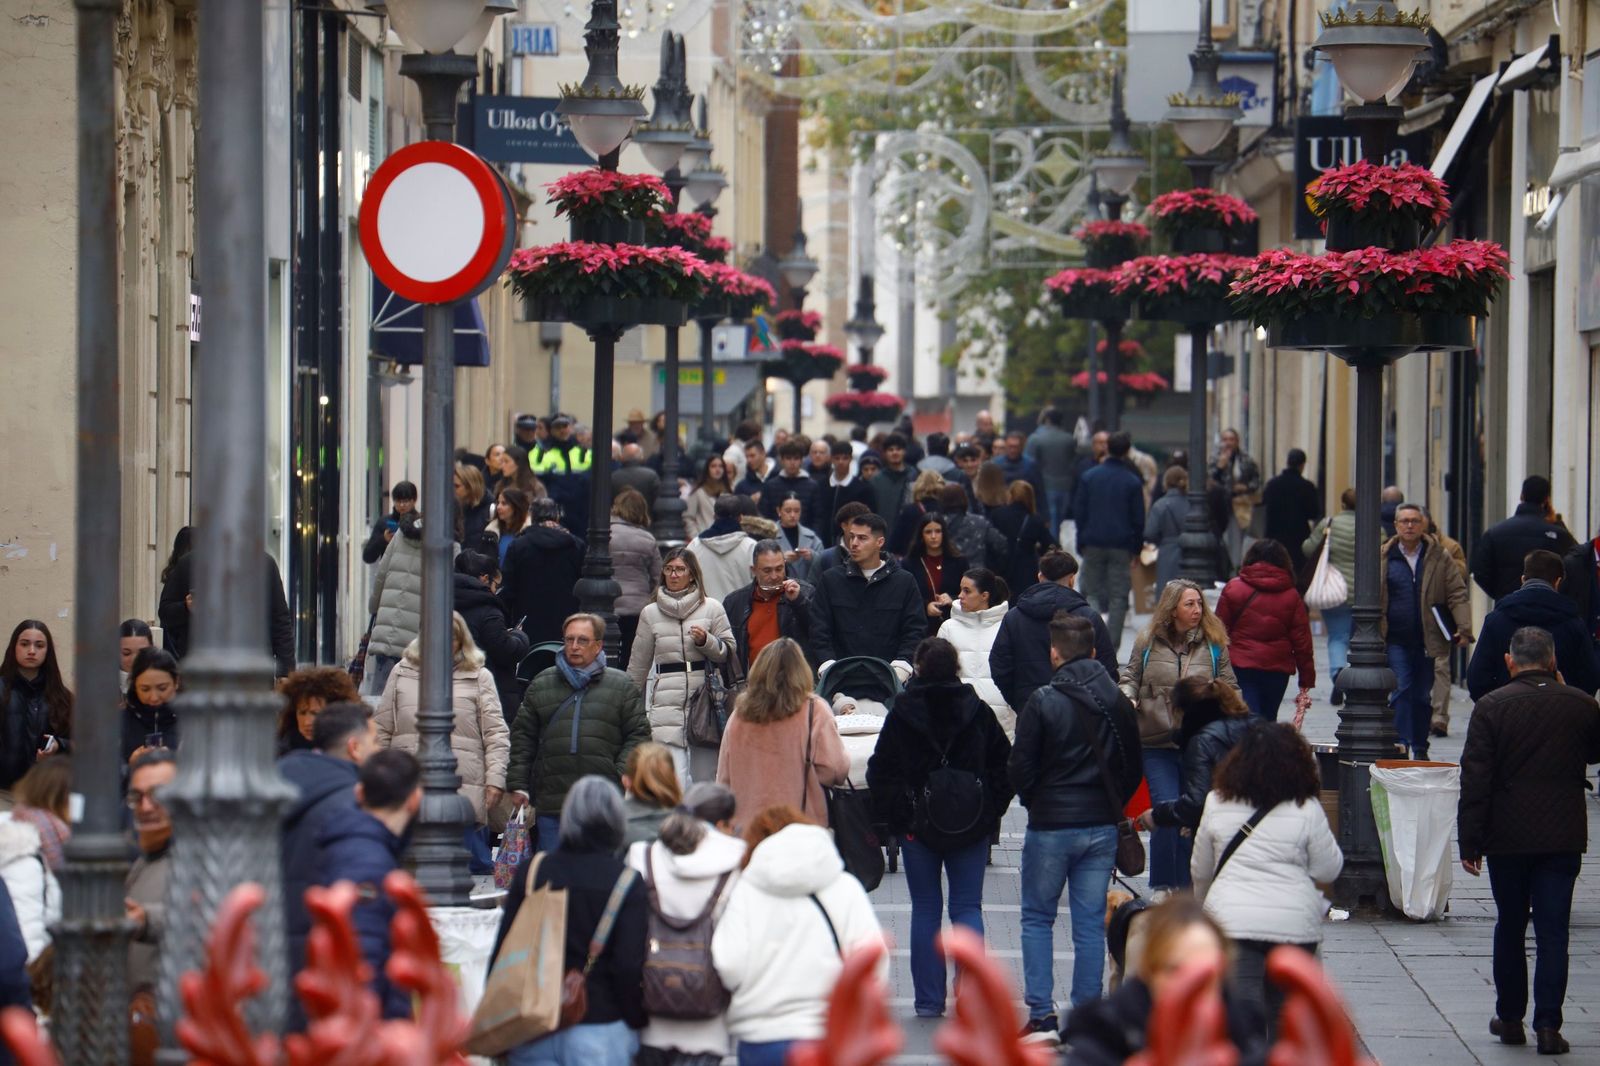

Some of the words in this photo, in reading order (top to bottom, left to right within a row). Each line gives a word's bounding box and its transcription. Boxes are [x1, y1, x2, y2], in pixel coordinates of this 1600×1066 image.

[486, 108, 537, 131] Ulloa
[540, 110, 574, 137] Op
[1305, 136, 1409, 172] Ulla
